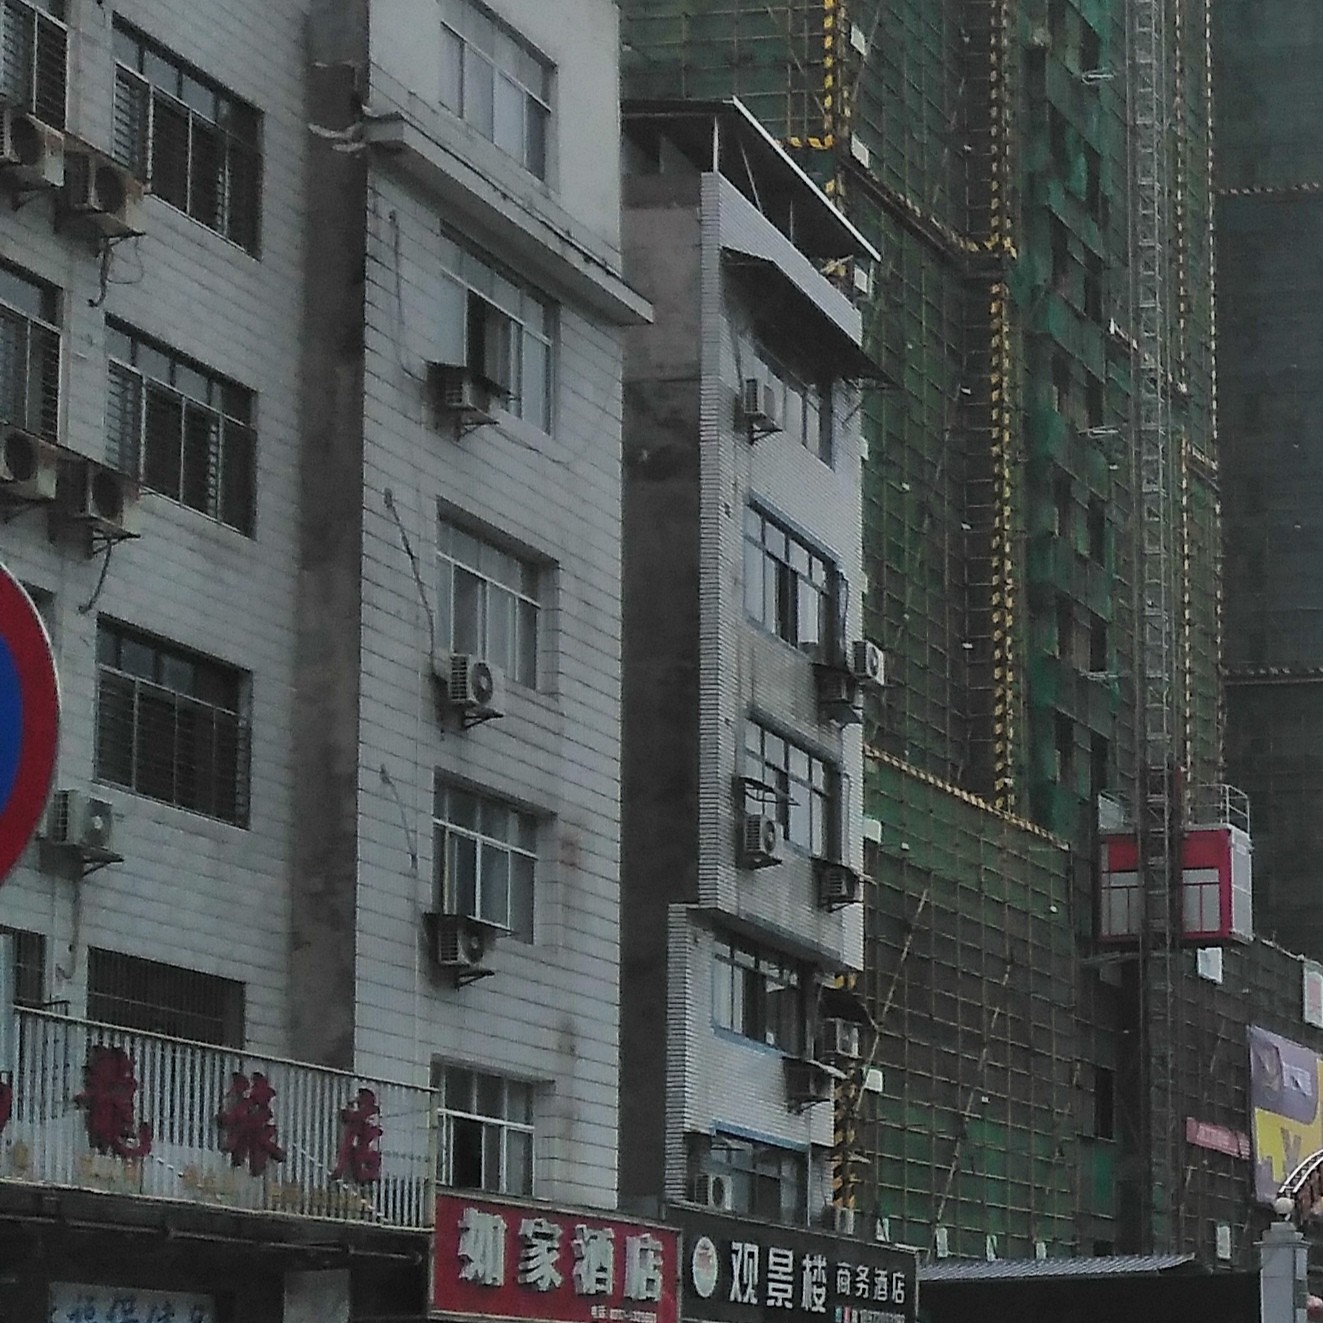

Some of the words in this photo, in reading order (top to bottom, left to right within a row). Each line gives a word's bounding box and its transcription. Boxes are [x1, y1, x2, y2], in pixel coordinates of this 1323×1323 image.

[457, 1206, 664, 1302] 如家酒店
[729, 1240, 828, 1314] 观景楼
[835, 1261, 906, 1304] 商务酒店
